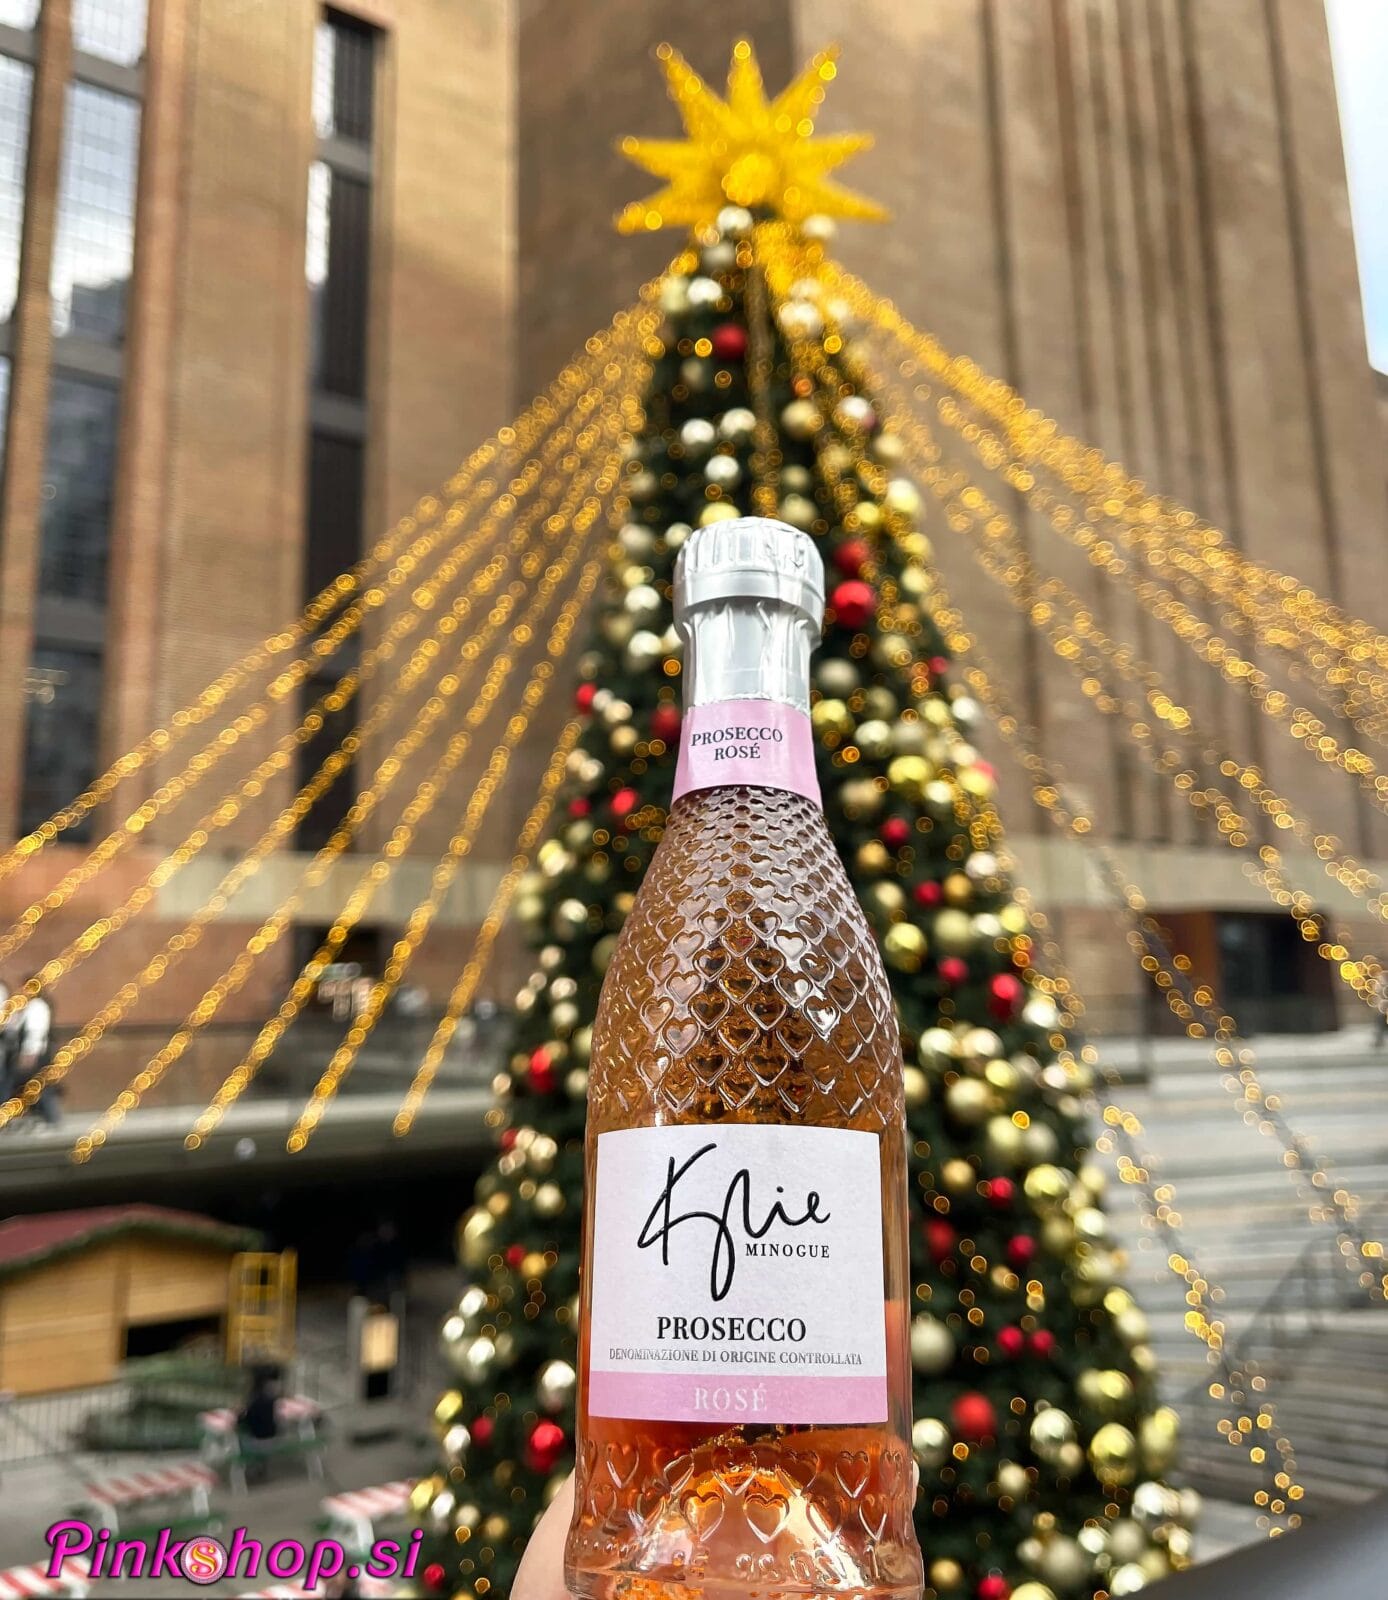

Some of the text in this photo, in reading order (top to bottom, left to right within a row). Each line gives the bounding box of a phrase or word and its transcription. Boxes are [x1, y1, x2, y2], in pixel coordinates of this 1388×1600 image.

[691, 727, 783, 746] PROSECCO
[714, 743, 761, 761] ROSÉ
[637, 1143, 831, 1301] Kylie
[745, 1243, 830, 1258] MINOGUE
[656, 1316, 806, 1341] PROSECCO
[609, 1348, 862, 1367] DENOMINAZIONE DI ORIGINE CONTROLLATA
[693, 1383, 767, 1412] ROSÉ
